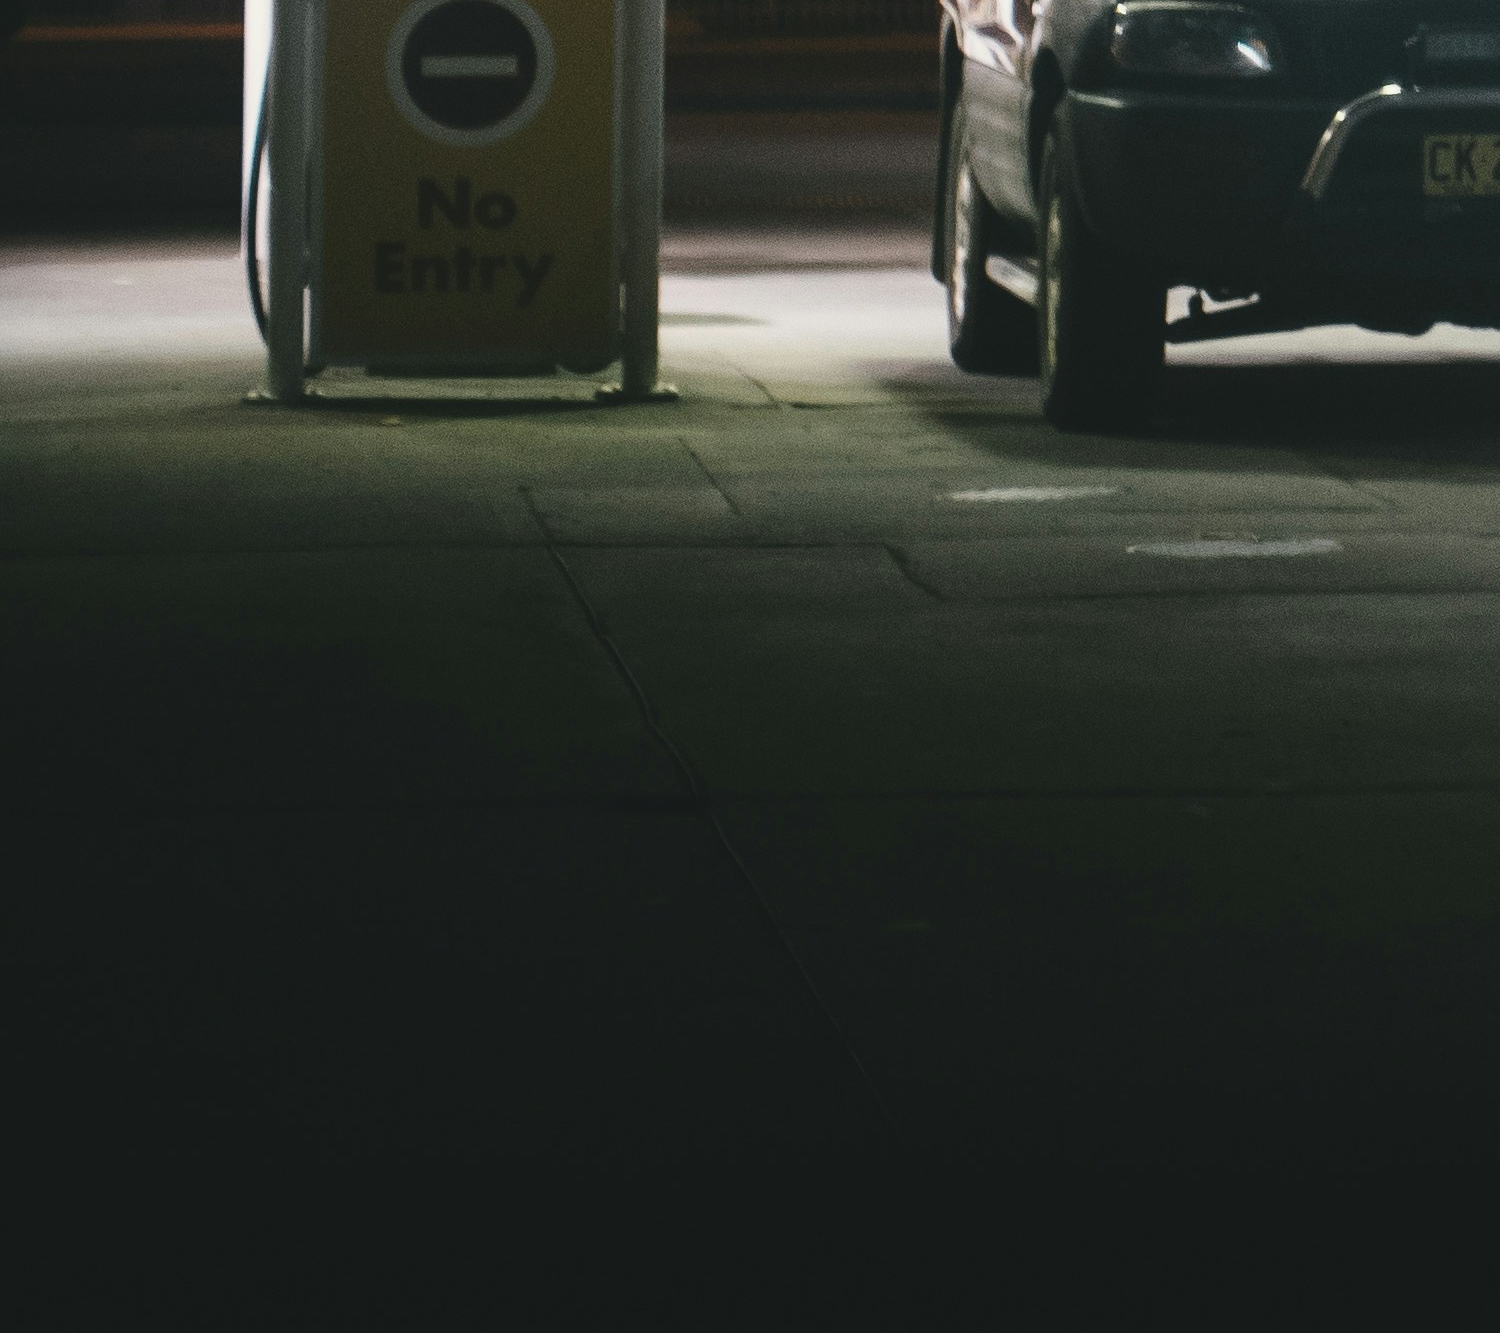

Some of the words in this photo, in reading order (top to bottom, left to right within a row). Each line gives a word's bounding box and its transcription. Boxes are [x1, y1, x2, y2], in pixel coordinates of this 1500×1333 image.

[1428, 140, 1478, 182] CK
[417, 175, 518, 231] No
[373, 239, 554, 309] Entry
